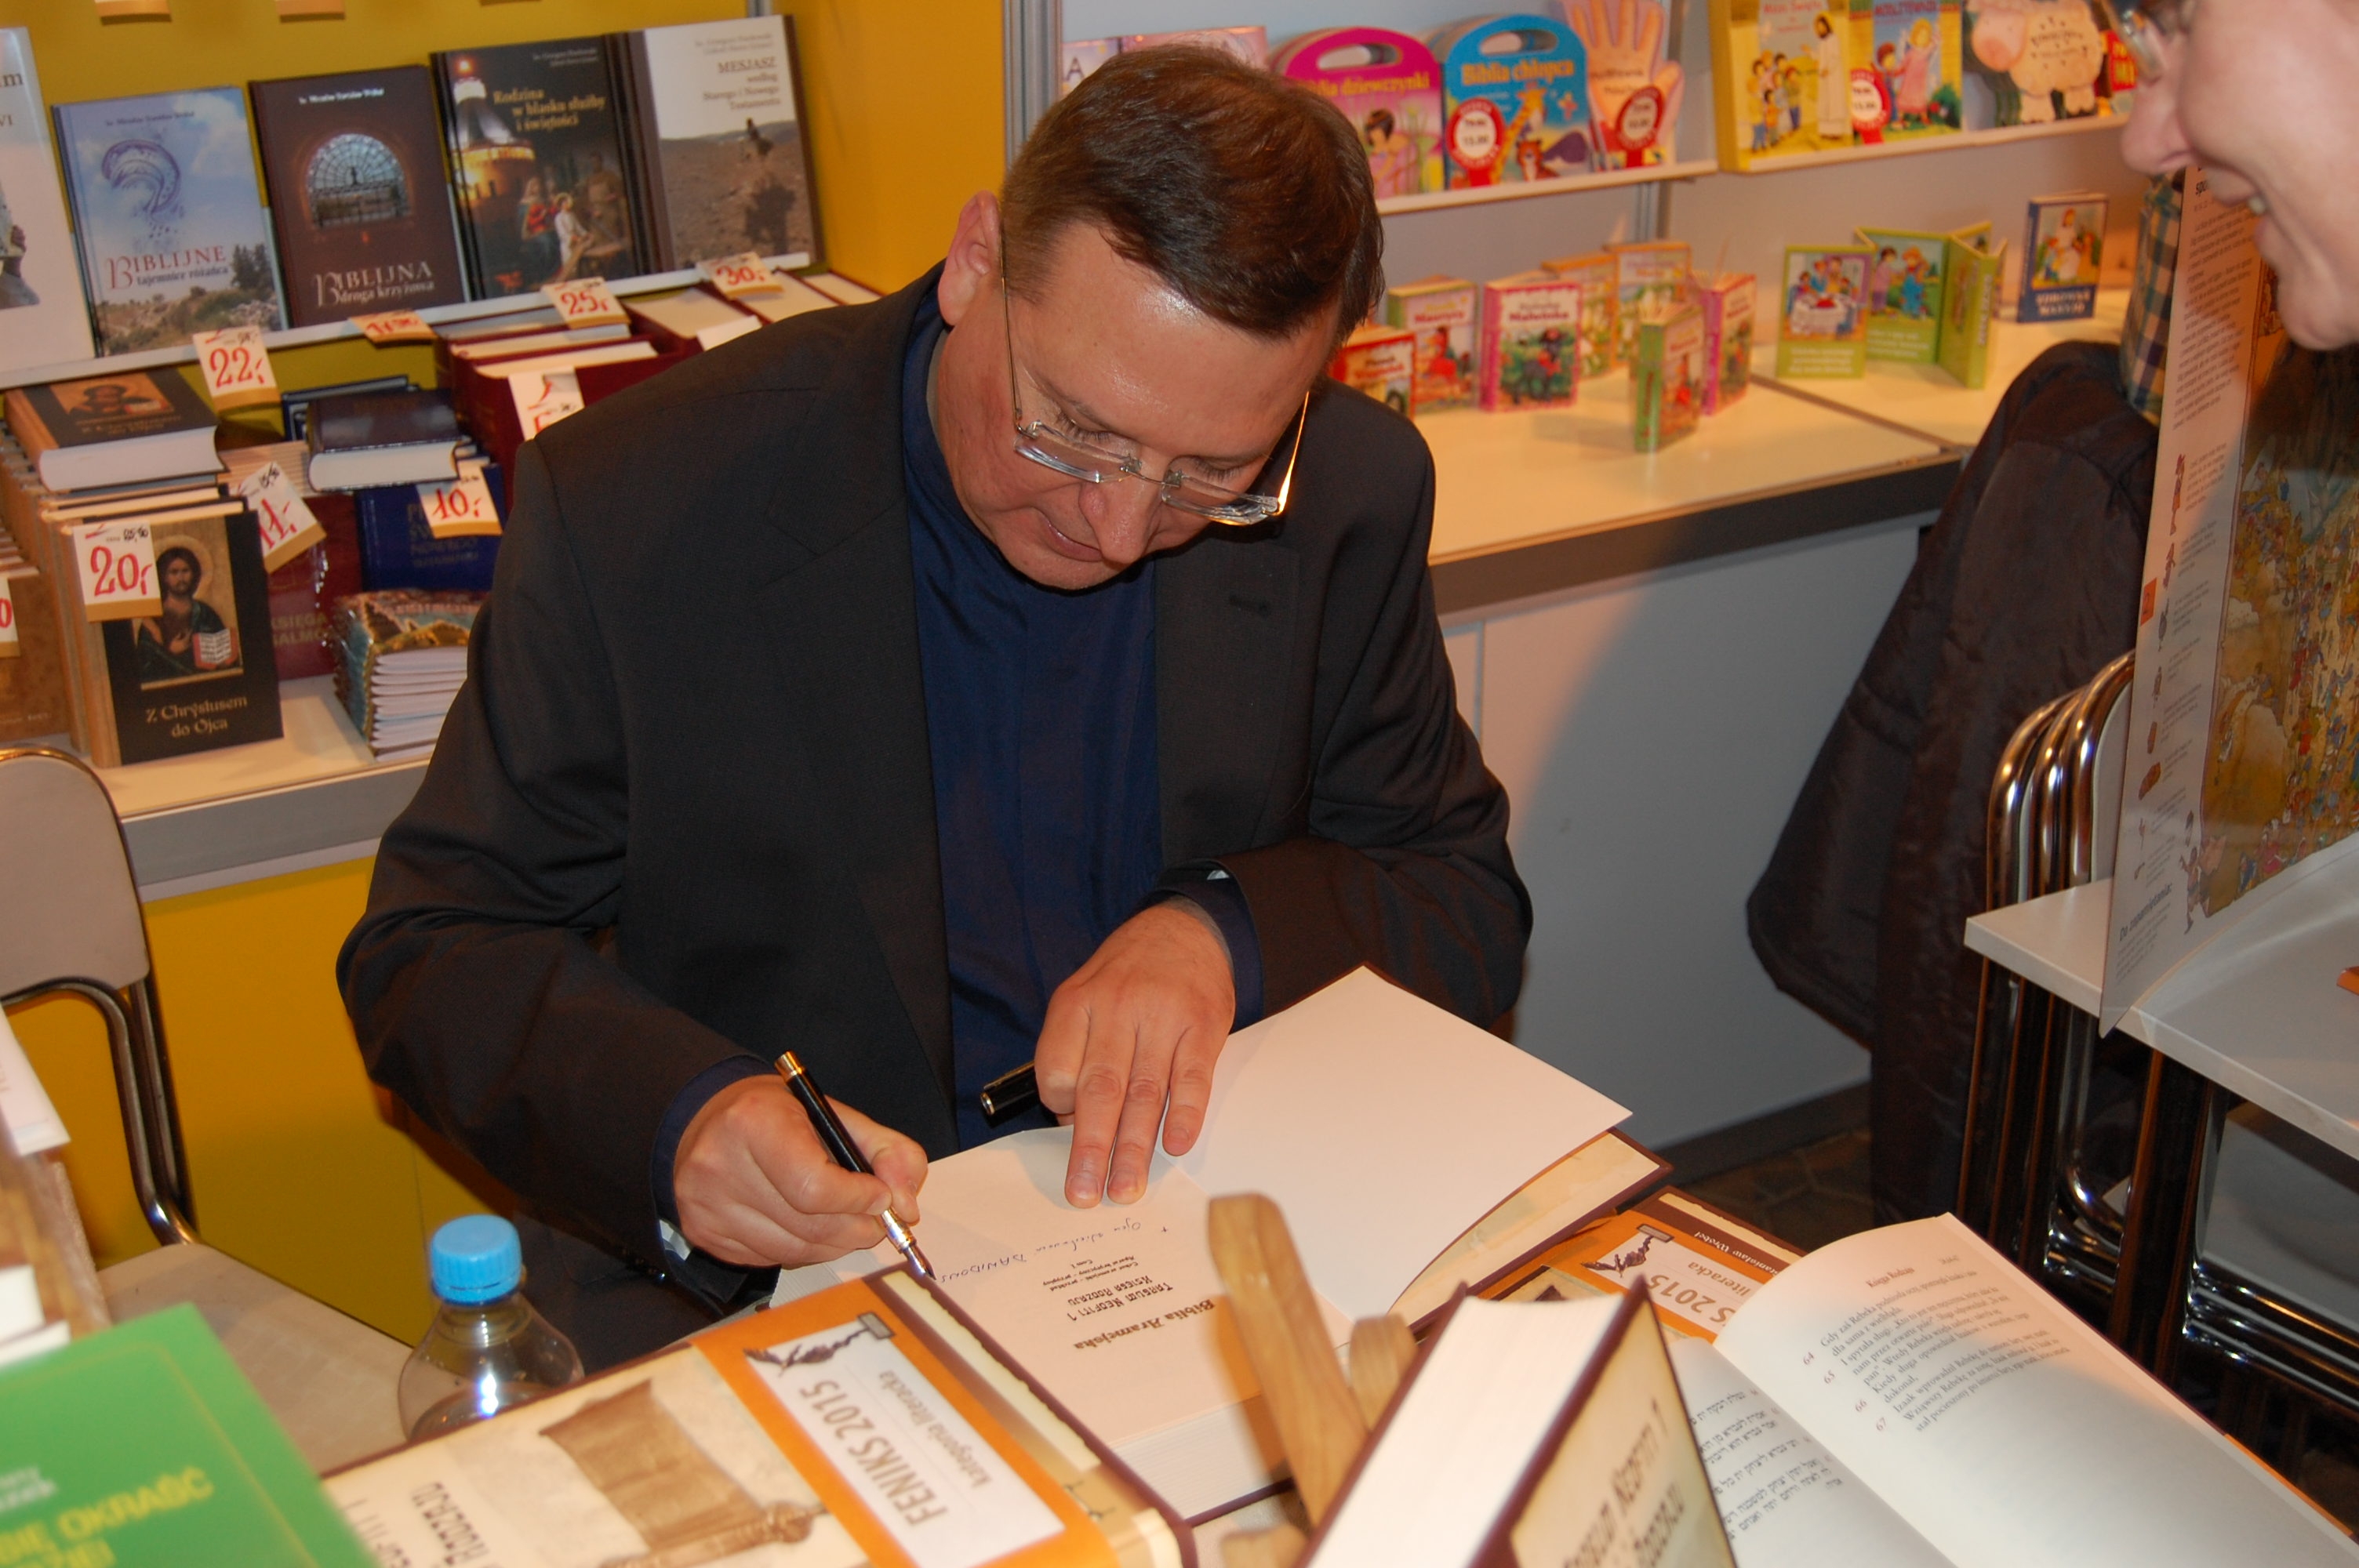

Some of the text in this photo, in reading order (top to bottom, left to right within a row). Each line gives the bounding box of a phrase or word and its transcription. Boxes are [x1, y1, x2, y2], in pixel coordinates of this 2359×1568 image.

[105, 245, 226, 290] BIBLIJNE
[314, 260, 432, 308] BIBLIJNA
[171, 718, 228, 739] do Ojca
[1645, 1274, 1717, 1314] 2015
[1687, 1261, 1751, 1297] literacka
[1073, 1298, 1216, 1349] Biblia Aramejska
[1803, 1351, 1815, 1366] 64
[1819, 1331, 1840, 1347] Gdy
[1881, 1348, 1910, 1367] Wtedy
[1823, 1369, 1836, 1385] 65
[1852, 1359, 1872, 1376] nam
[1855, 1399, 1868, 1413] 66
[1870, 1374, 1898, 1395] Kiedy
[1875, 1417, 1887, 1432] 67
[798, 1379, 949, 1527] FENIKS 2015
